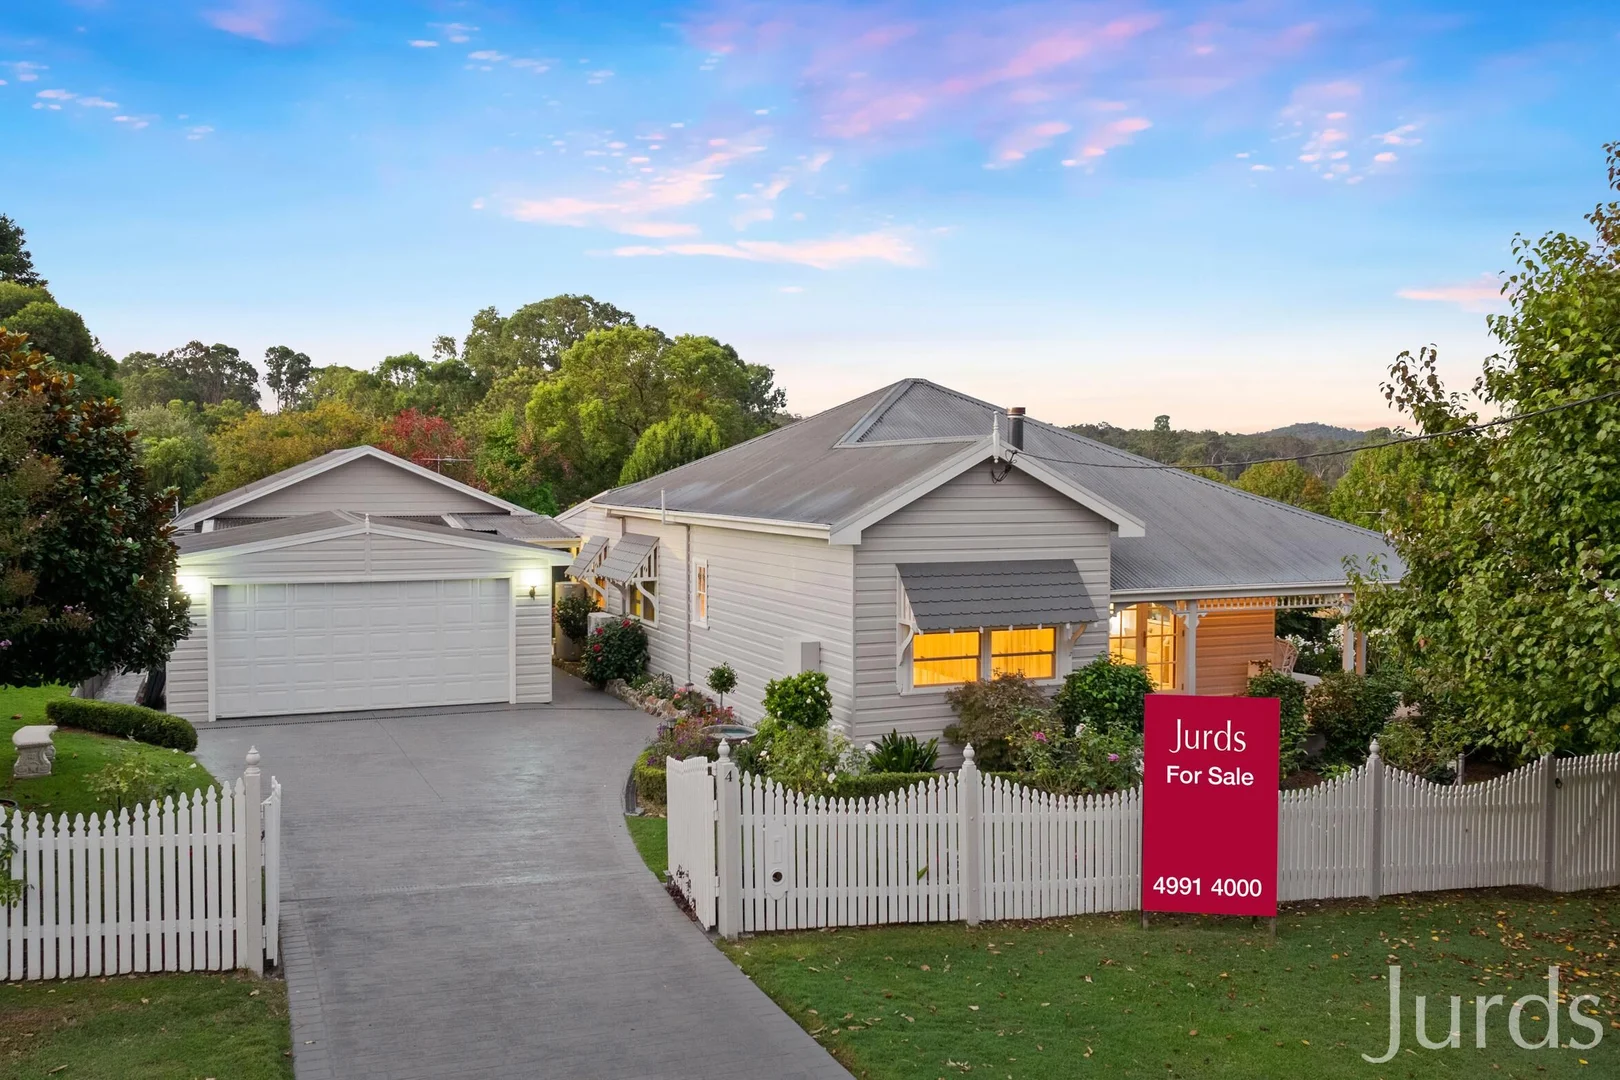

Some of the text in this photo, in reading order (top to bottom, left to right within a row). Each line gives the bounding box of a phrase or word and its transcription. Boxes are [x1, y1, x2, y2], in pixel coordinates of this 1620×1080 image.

[1169, 718, 1247, 754] Jurds
[725, 770, 732, 782] 4
[1166, 765, 1254, 786] For Sale
[1153, 876, 1262, 897] 4991 4000
